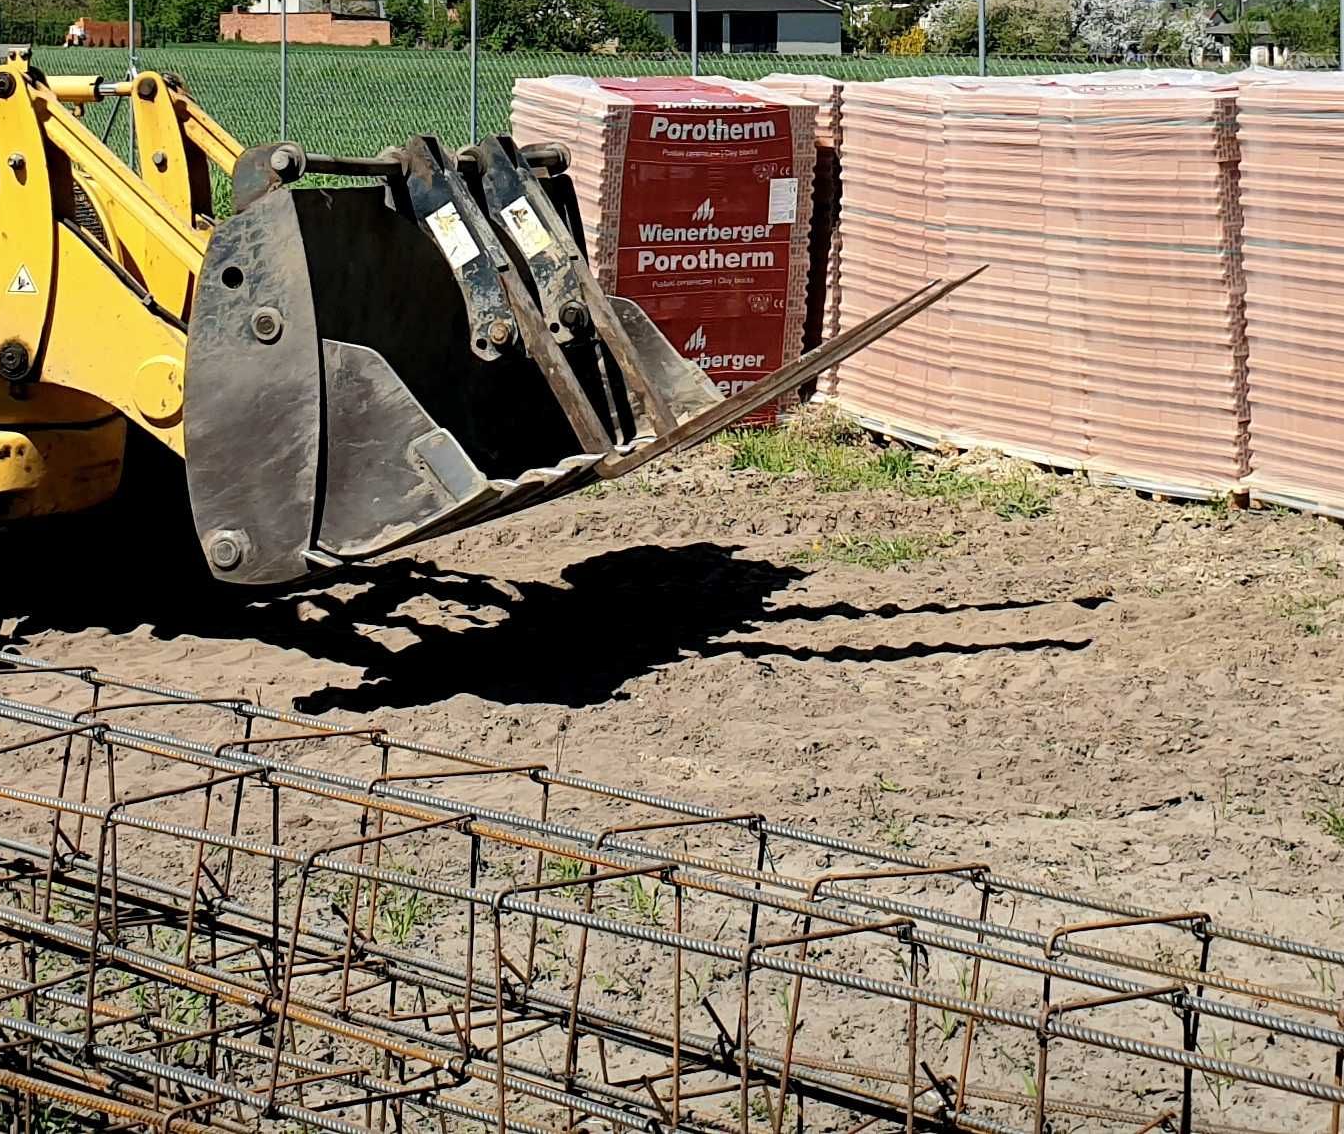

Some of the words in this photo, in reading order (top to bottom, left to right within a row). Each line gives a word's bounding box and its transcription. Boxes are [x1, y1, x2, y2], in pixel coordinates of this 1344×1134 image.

[650, 116, 775, 141] Porotherm
[638, 223, 774, 242] Wienerberger
[637, 248, 774, 273] Porotherm
